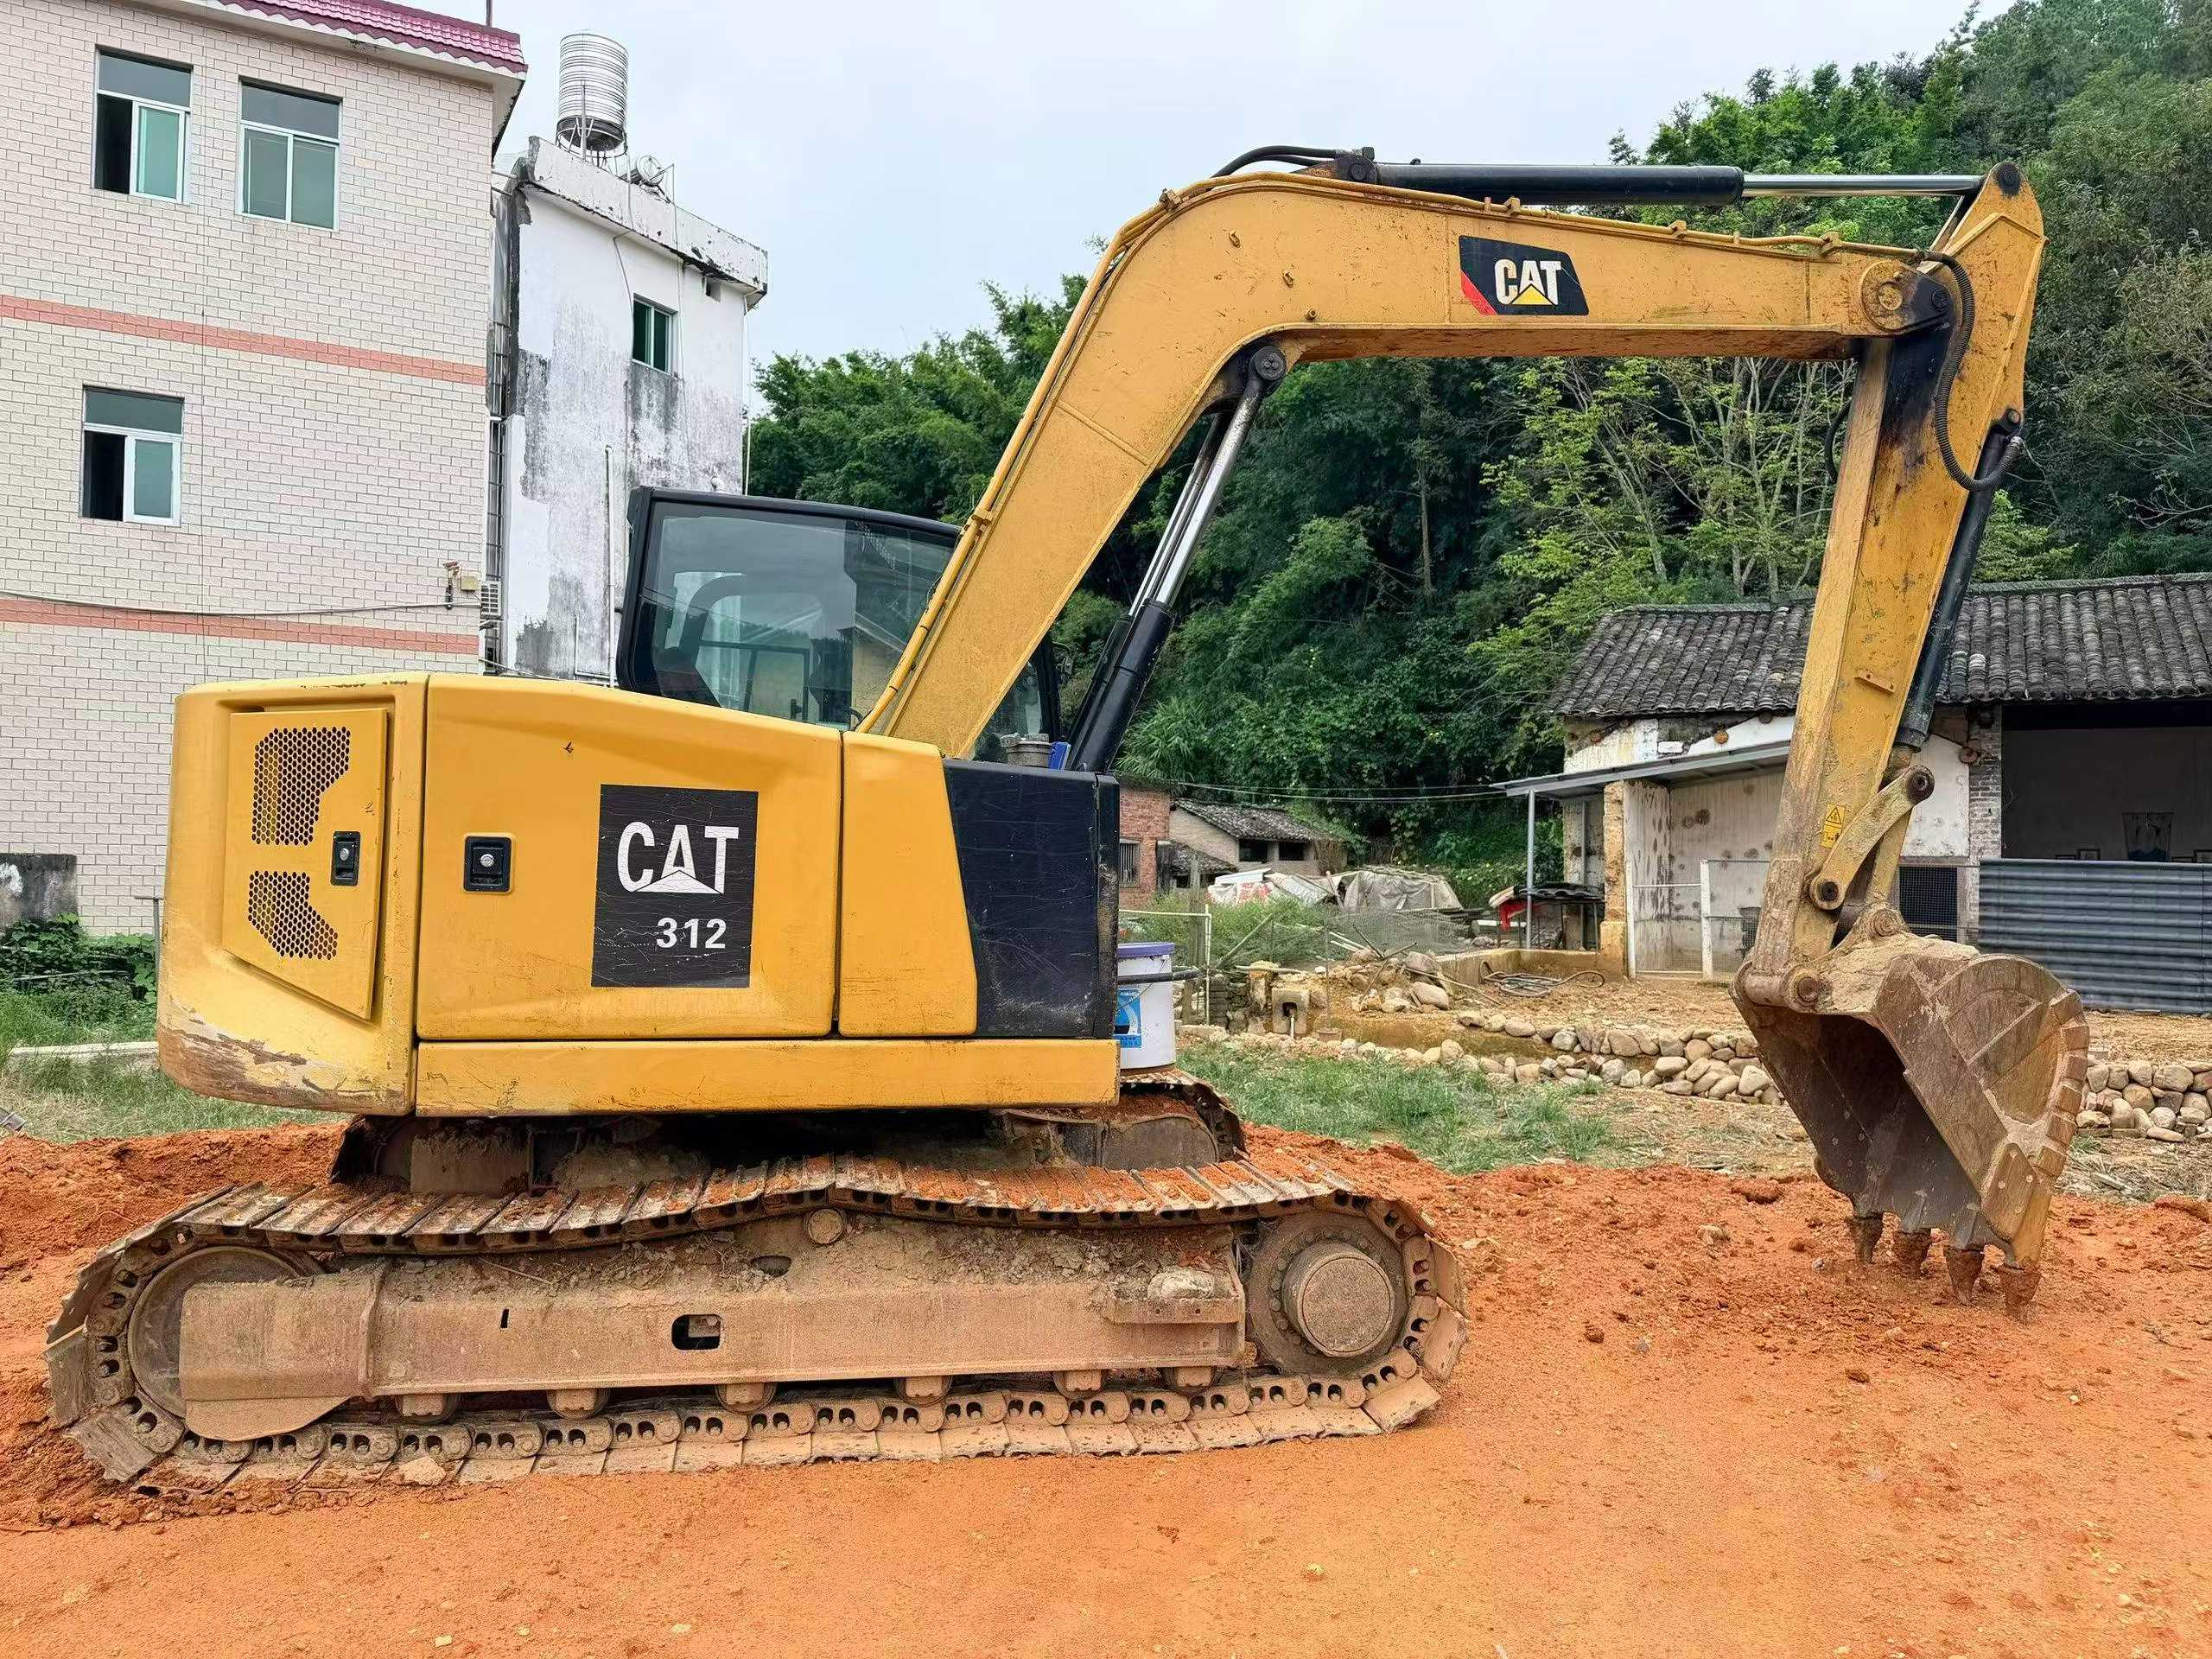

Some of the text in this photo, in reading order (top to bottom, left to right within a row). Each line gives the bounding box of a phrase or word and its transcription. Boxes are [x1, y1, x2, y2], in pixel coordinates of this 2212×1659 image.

[1494, 258, 1562, 306] CAT
[617, 821, 740, 894] CAT
[656, 917, 727, 949] 312
